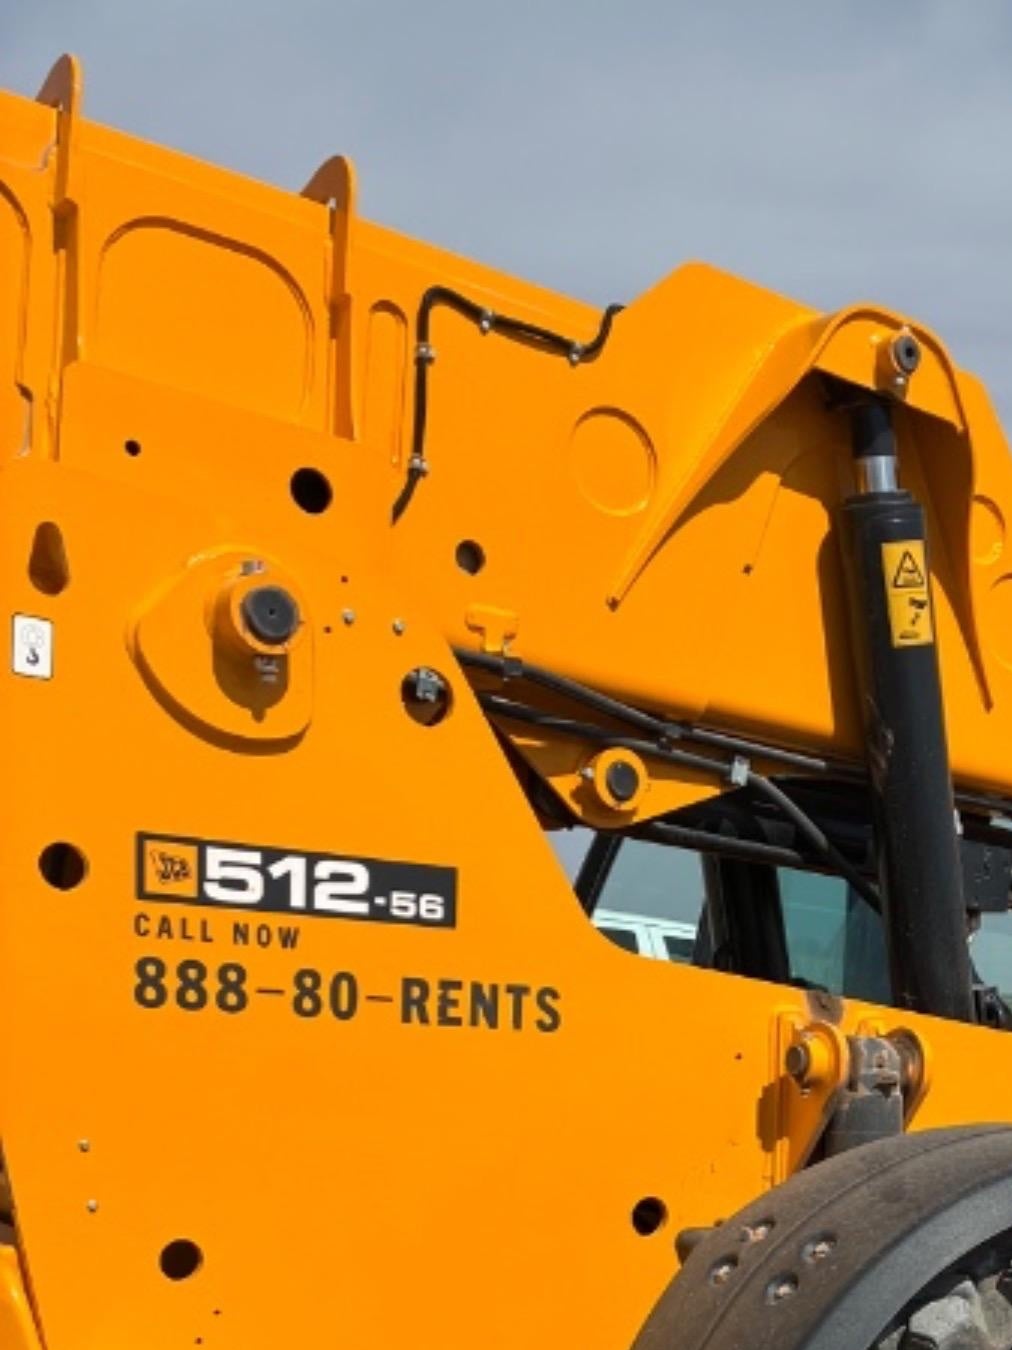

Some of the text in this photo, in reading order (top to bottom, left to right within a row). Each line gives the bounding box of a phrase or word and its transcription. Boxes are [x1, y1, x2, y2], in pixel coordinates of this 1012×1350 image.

[134, 912, 299, 949] CALL NOW
[134, 956, 561, 1032] 888-80-RENTS
